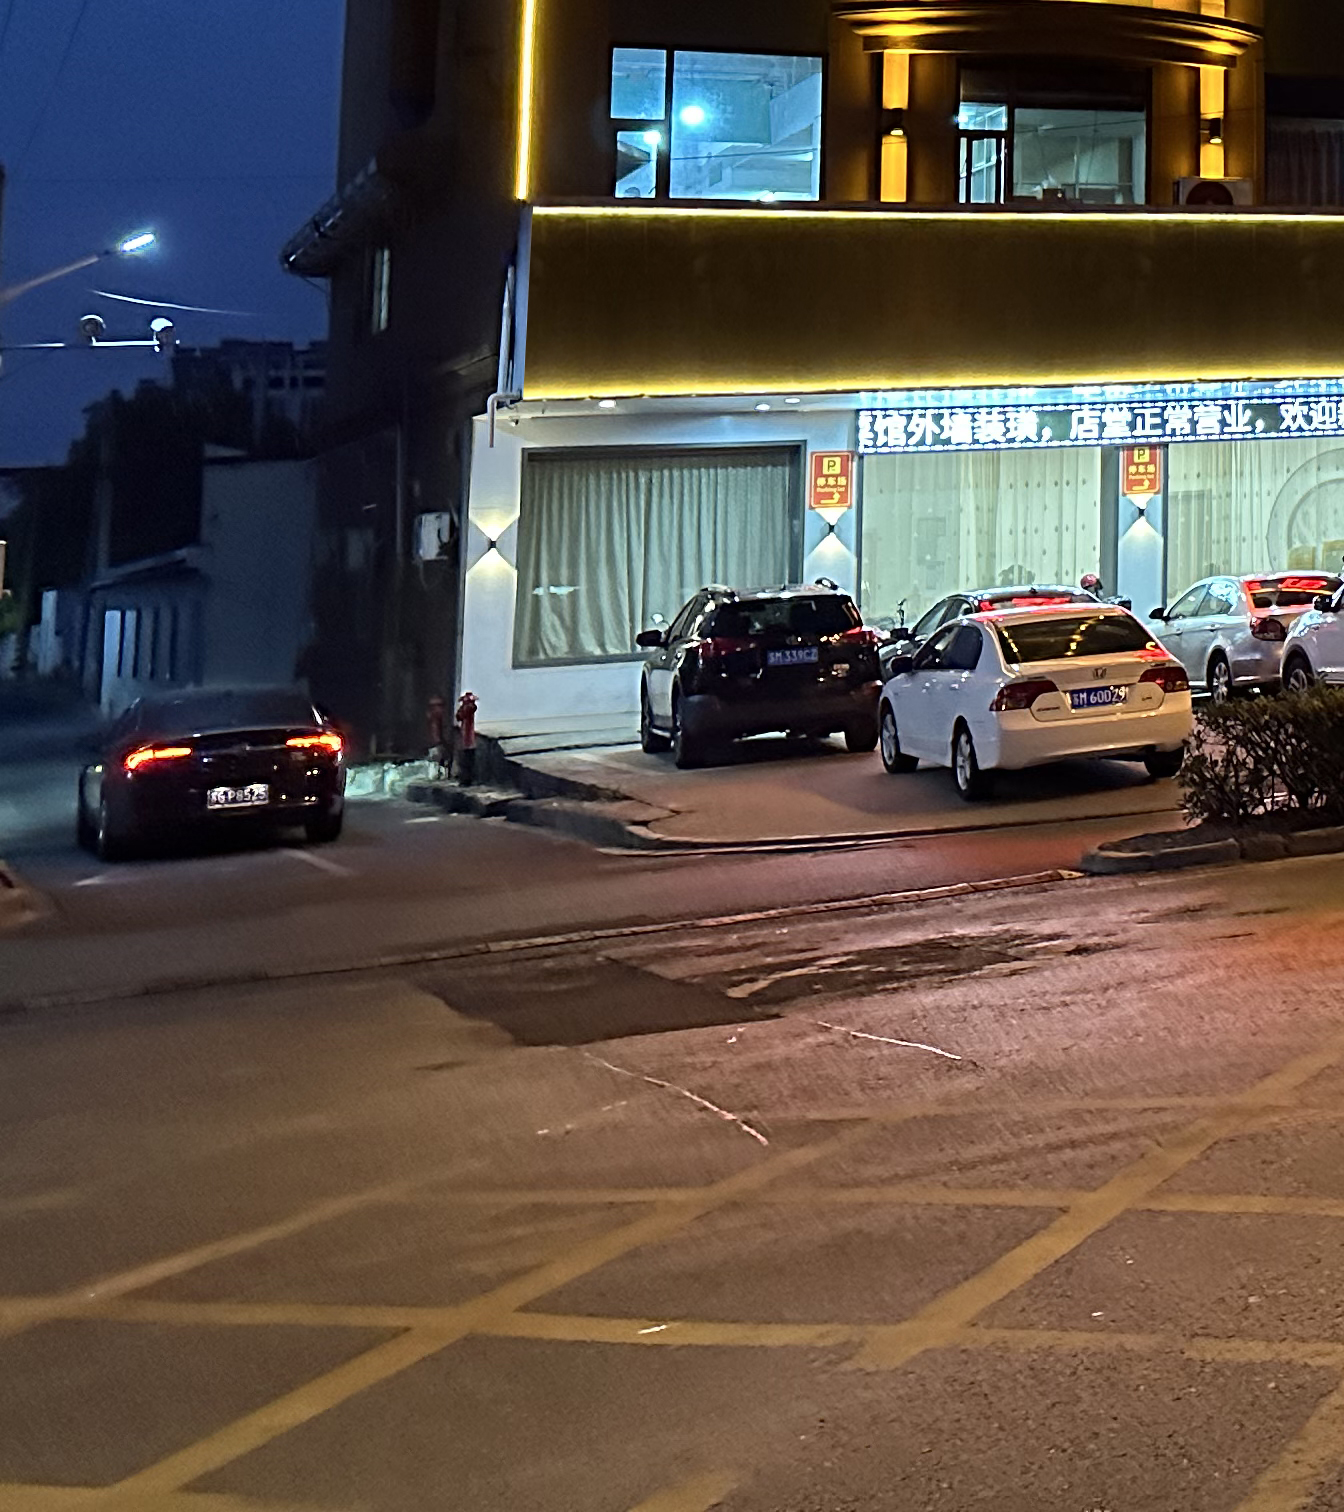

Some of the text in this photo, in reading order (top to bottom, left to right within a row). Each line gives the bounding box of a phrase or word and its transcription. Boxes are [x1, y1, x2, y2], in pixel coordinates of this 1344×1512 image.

[827, 459, 837, 472] P
[816, 476, 848, 487] 停车场
